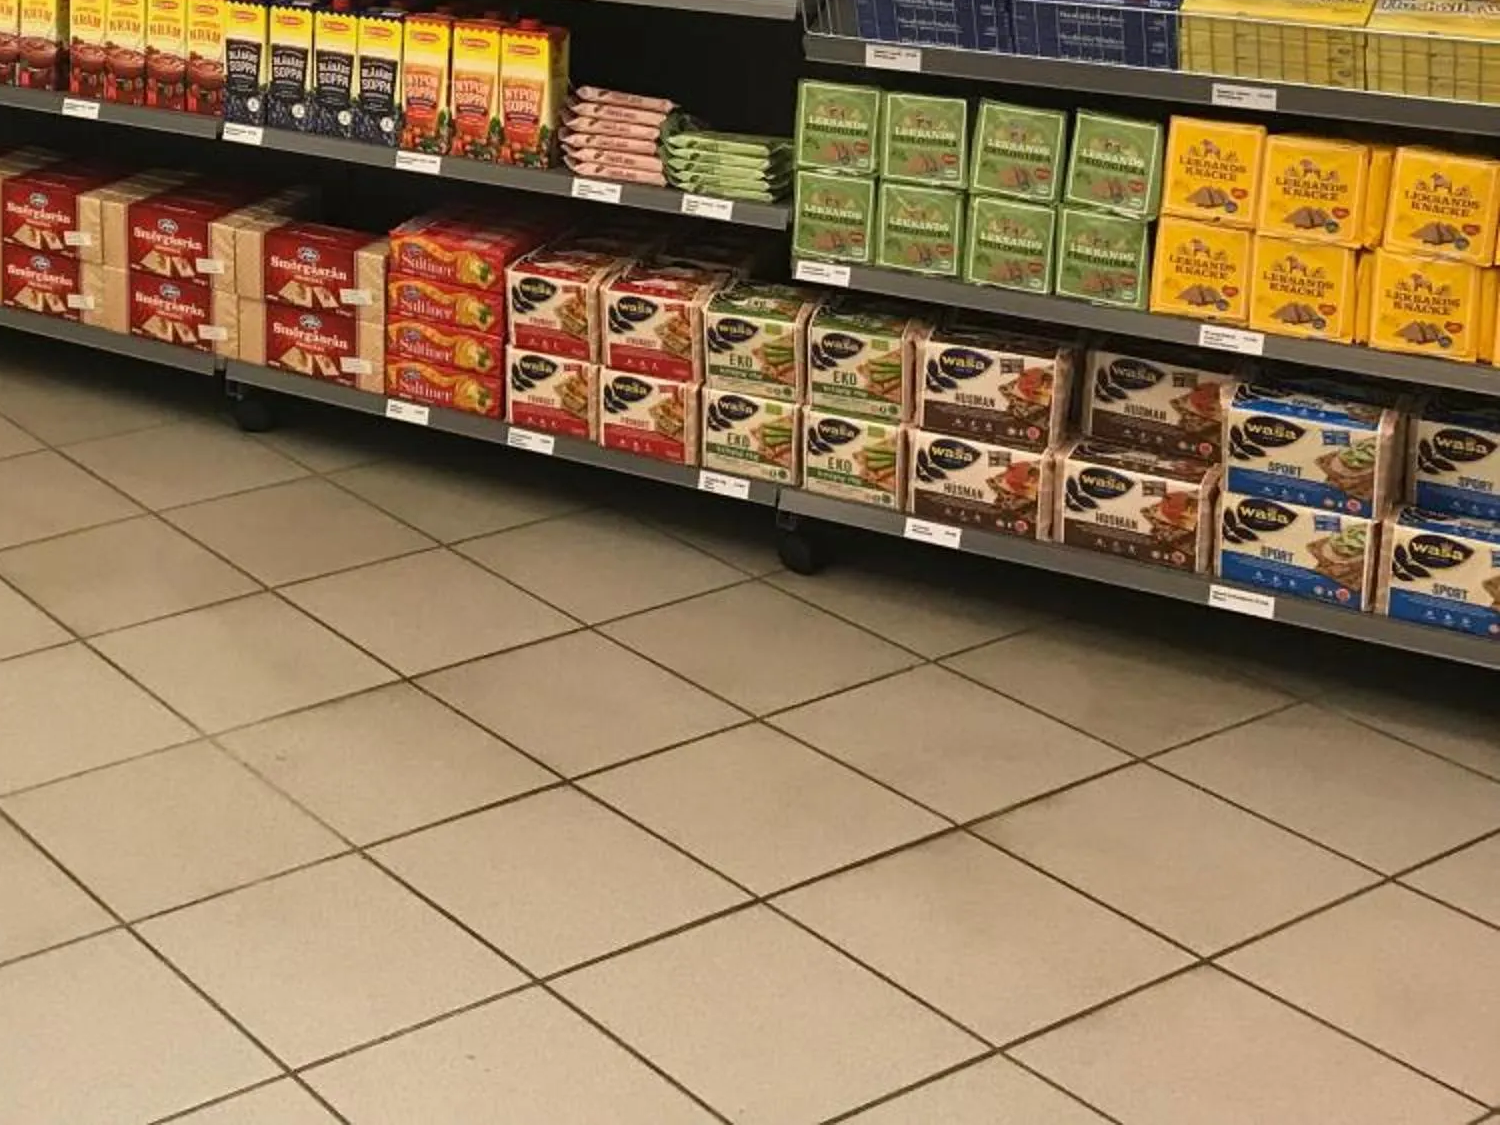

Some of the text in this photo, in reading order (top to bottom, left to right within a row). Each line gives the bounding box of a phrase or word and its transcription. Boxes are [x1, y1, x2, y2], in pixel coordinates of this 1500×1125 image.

[820, 336, 860, 353] wasa
[729, 353, 753, 369] EKO
[940, 352, 986, 371] wasa
[833, 370, 857, 386] EKO
[727, 432, 750, 448] EKO
[817, 423, 856, 441] wasa
[1247, 422, 1296, 445] wasa
[930, 443, 974, 462] wasa
[1436, 435, 1489, 456] wasa
[827, 457, 852, 472] EKO
[1268, 460, 1304, 477] SPORT
[1080, 473, 1126, 492] wasa
[1457, 476, 1493, 492] SPORT
[1239, 504, 1289, 525] wasa
[1260, 545, 1294, 564] SPORT
[1412, 541, 1465, 563] wasa
[1432, 582, 1469, 601] SPORT
